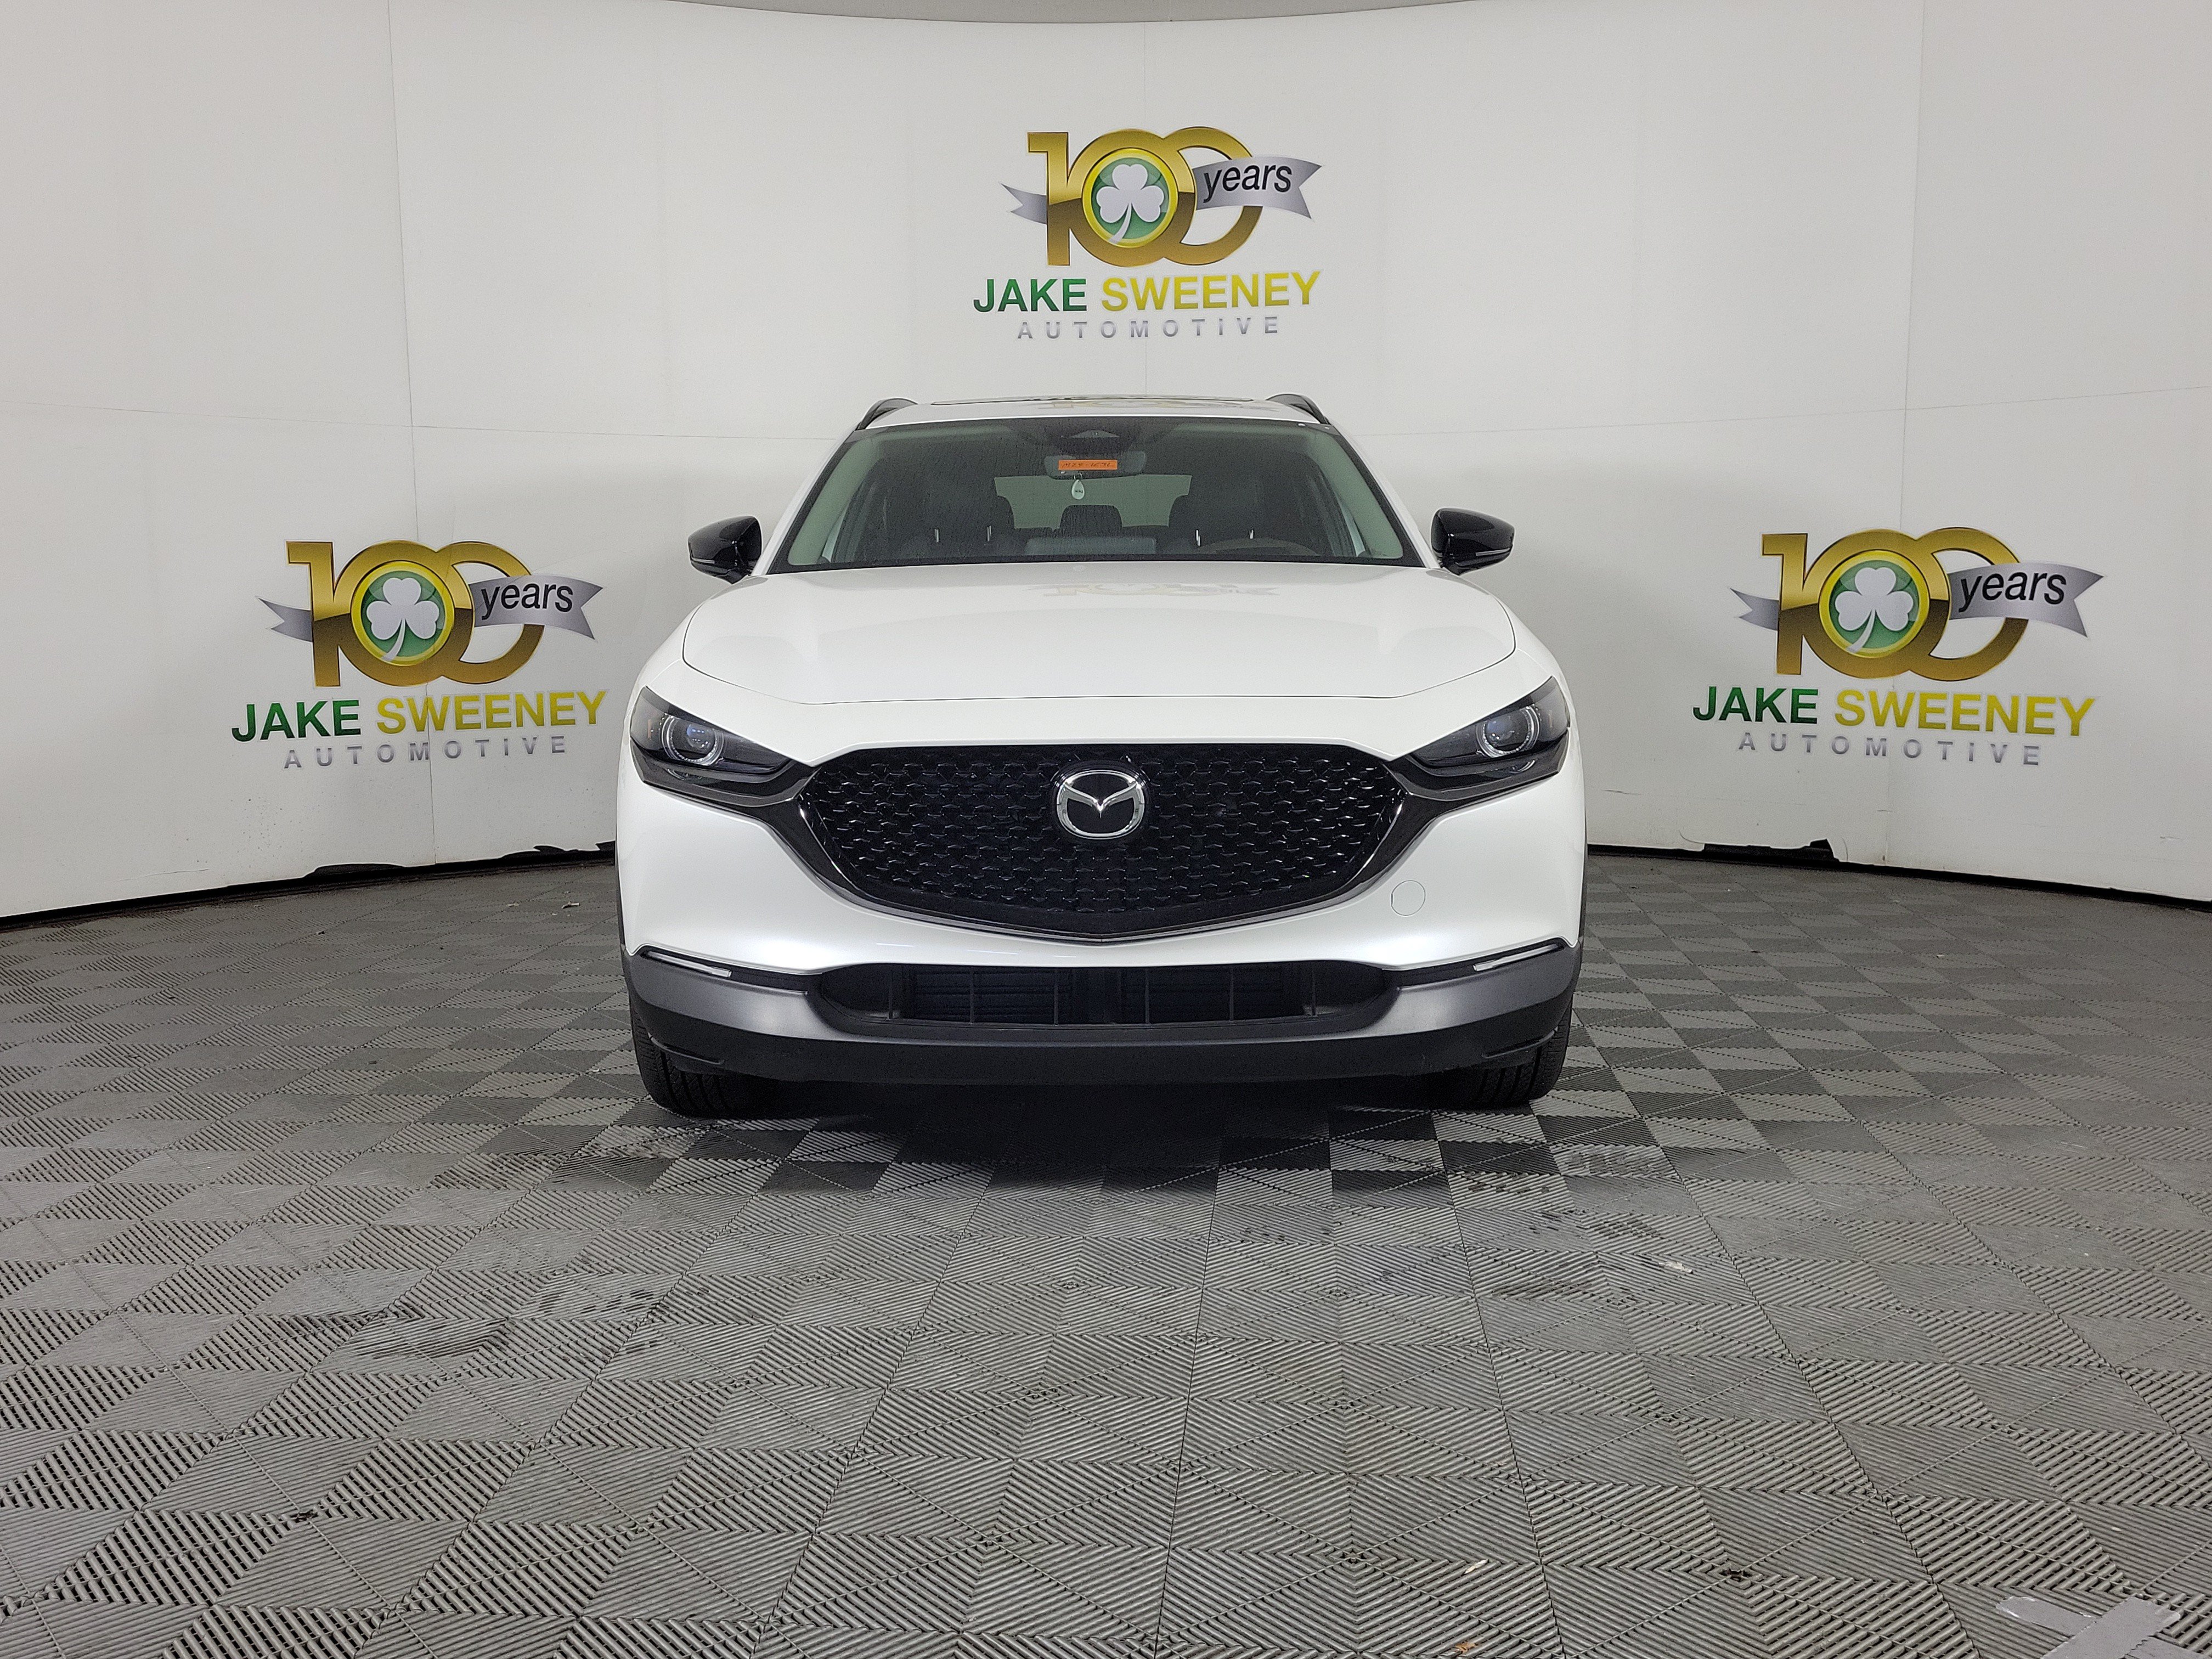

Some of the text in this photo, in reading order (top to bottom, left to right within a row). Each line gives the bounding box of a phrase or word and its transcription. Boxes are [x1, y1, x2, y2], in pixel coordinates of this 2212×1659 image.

[1203, 164, 1293, 203] years
[973, 270, 1321, 313] JAKE SWEENEY
[1017, 317, 1278, 339] AUTOMOTIVE
[481, 583, 573, 620] years
[1958, 571, 2067, 613] years
[232, 690, 607, 742] JAKE SWEENEY
[1693, 686, 2096, 736] JAKE SWEENEY
[284, 736, 566, 769] AUTOMOTIVE
[1739, 732, 2040, 765] AUTOMOTIVE
